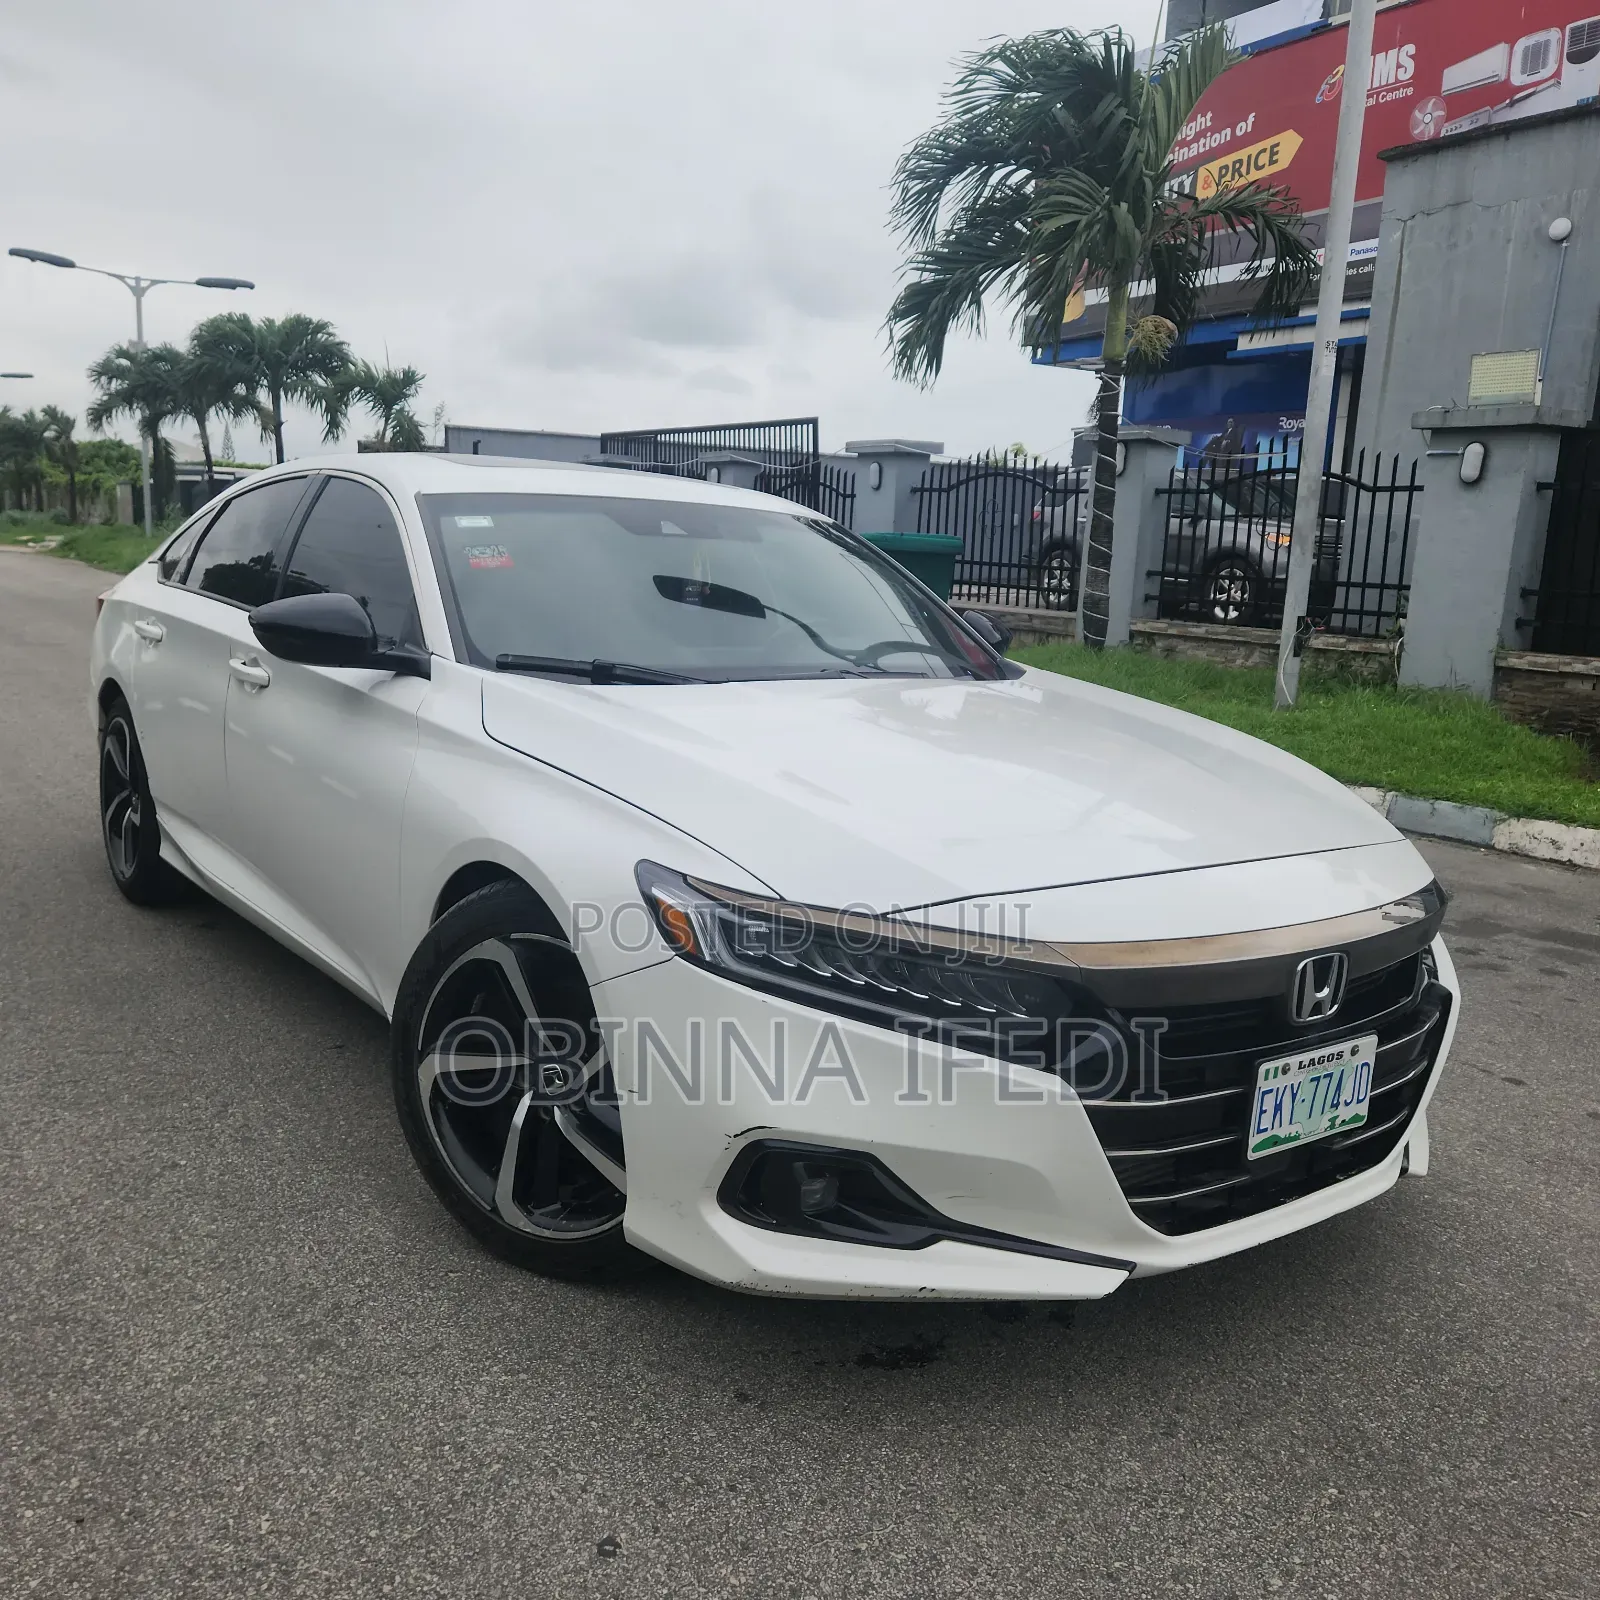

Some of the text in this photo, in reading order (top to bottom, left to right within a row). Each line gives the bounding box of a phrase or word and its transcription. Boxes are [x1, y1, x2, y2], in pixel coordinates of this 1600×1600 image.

[1378, 86, 1414, 103] Centre
[1177, 110, 1213, 141] ight
[1235, 112, 1256, 137] of
[1216, 142, 1281, 187] PRICE
[1349, 246, 1379, 257] Panaso
[1358, 263, 1376, 274] call:
[1279, 416, 1306, 432] Roya
[1297, 1050, 1345, 1071] LAGOS
[1255, 1061, 1371, 1135] EKY-774JD
